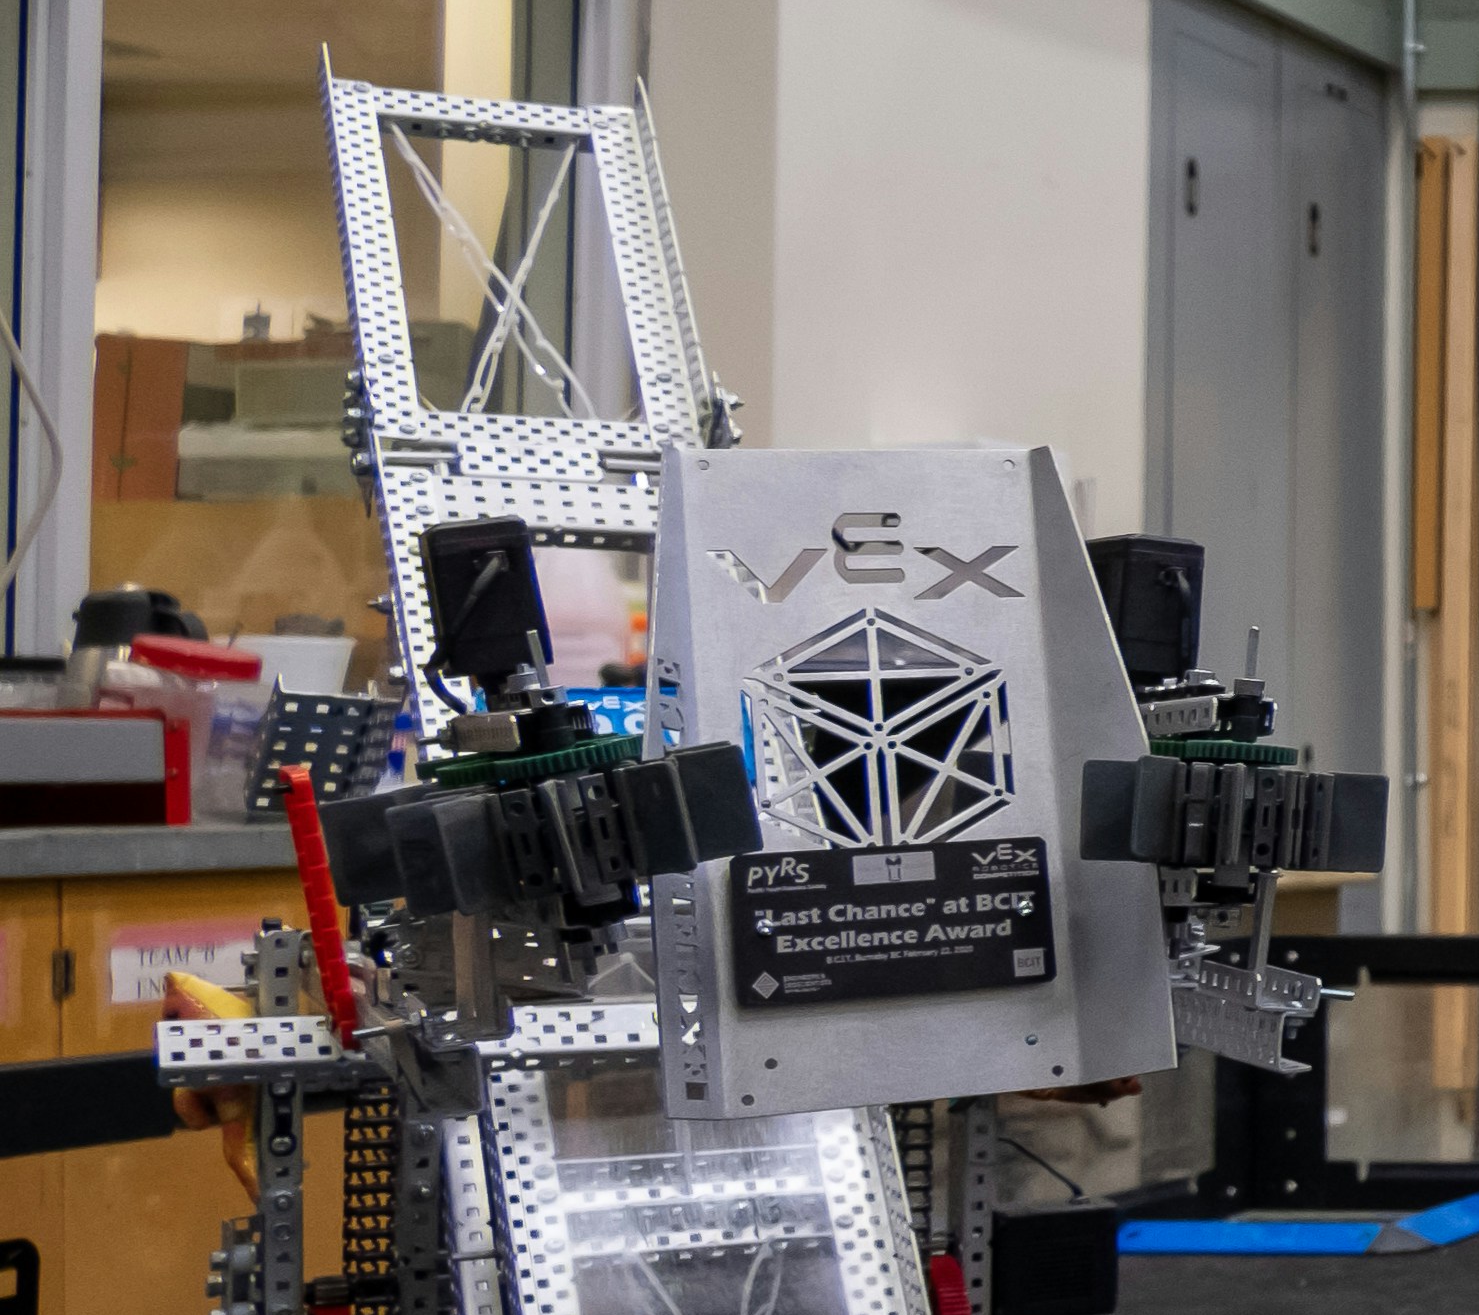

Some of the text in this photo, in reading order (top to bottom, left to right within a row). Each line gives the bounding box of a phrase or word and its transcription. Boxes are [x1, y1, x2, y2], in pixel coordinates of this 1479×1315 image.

[706, 512, 1026, 604] VEX
[971, 843, 1037, 864] VEX
[748, 857, 810, 886] PYRS
[828, 897, 937, 922] Chance"
[943, 896, 969, 914] at
[776, 919, 1012, 954] Excellence Award
